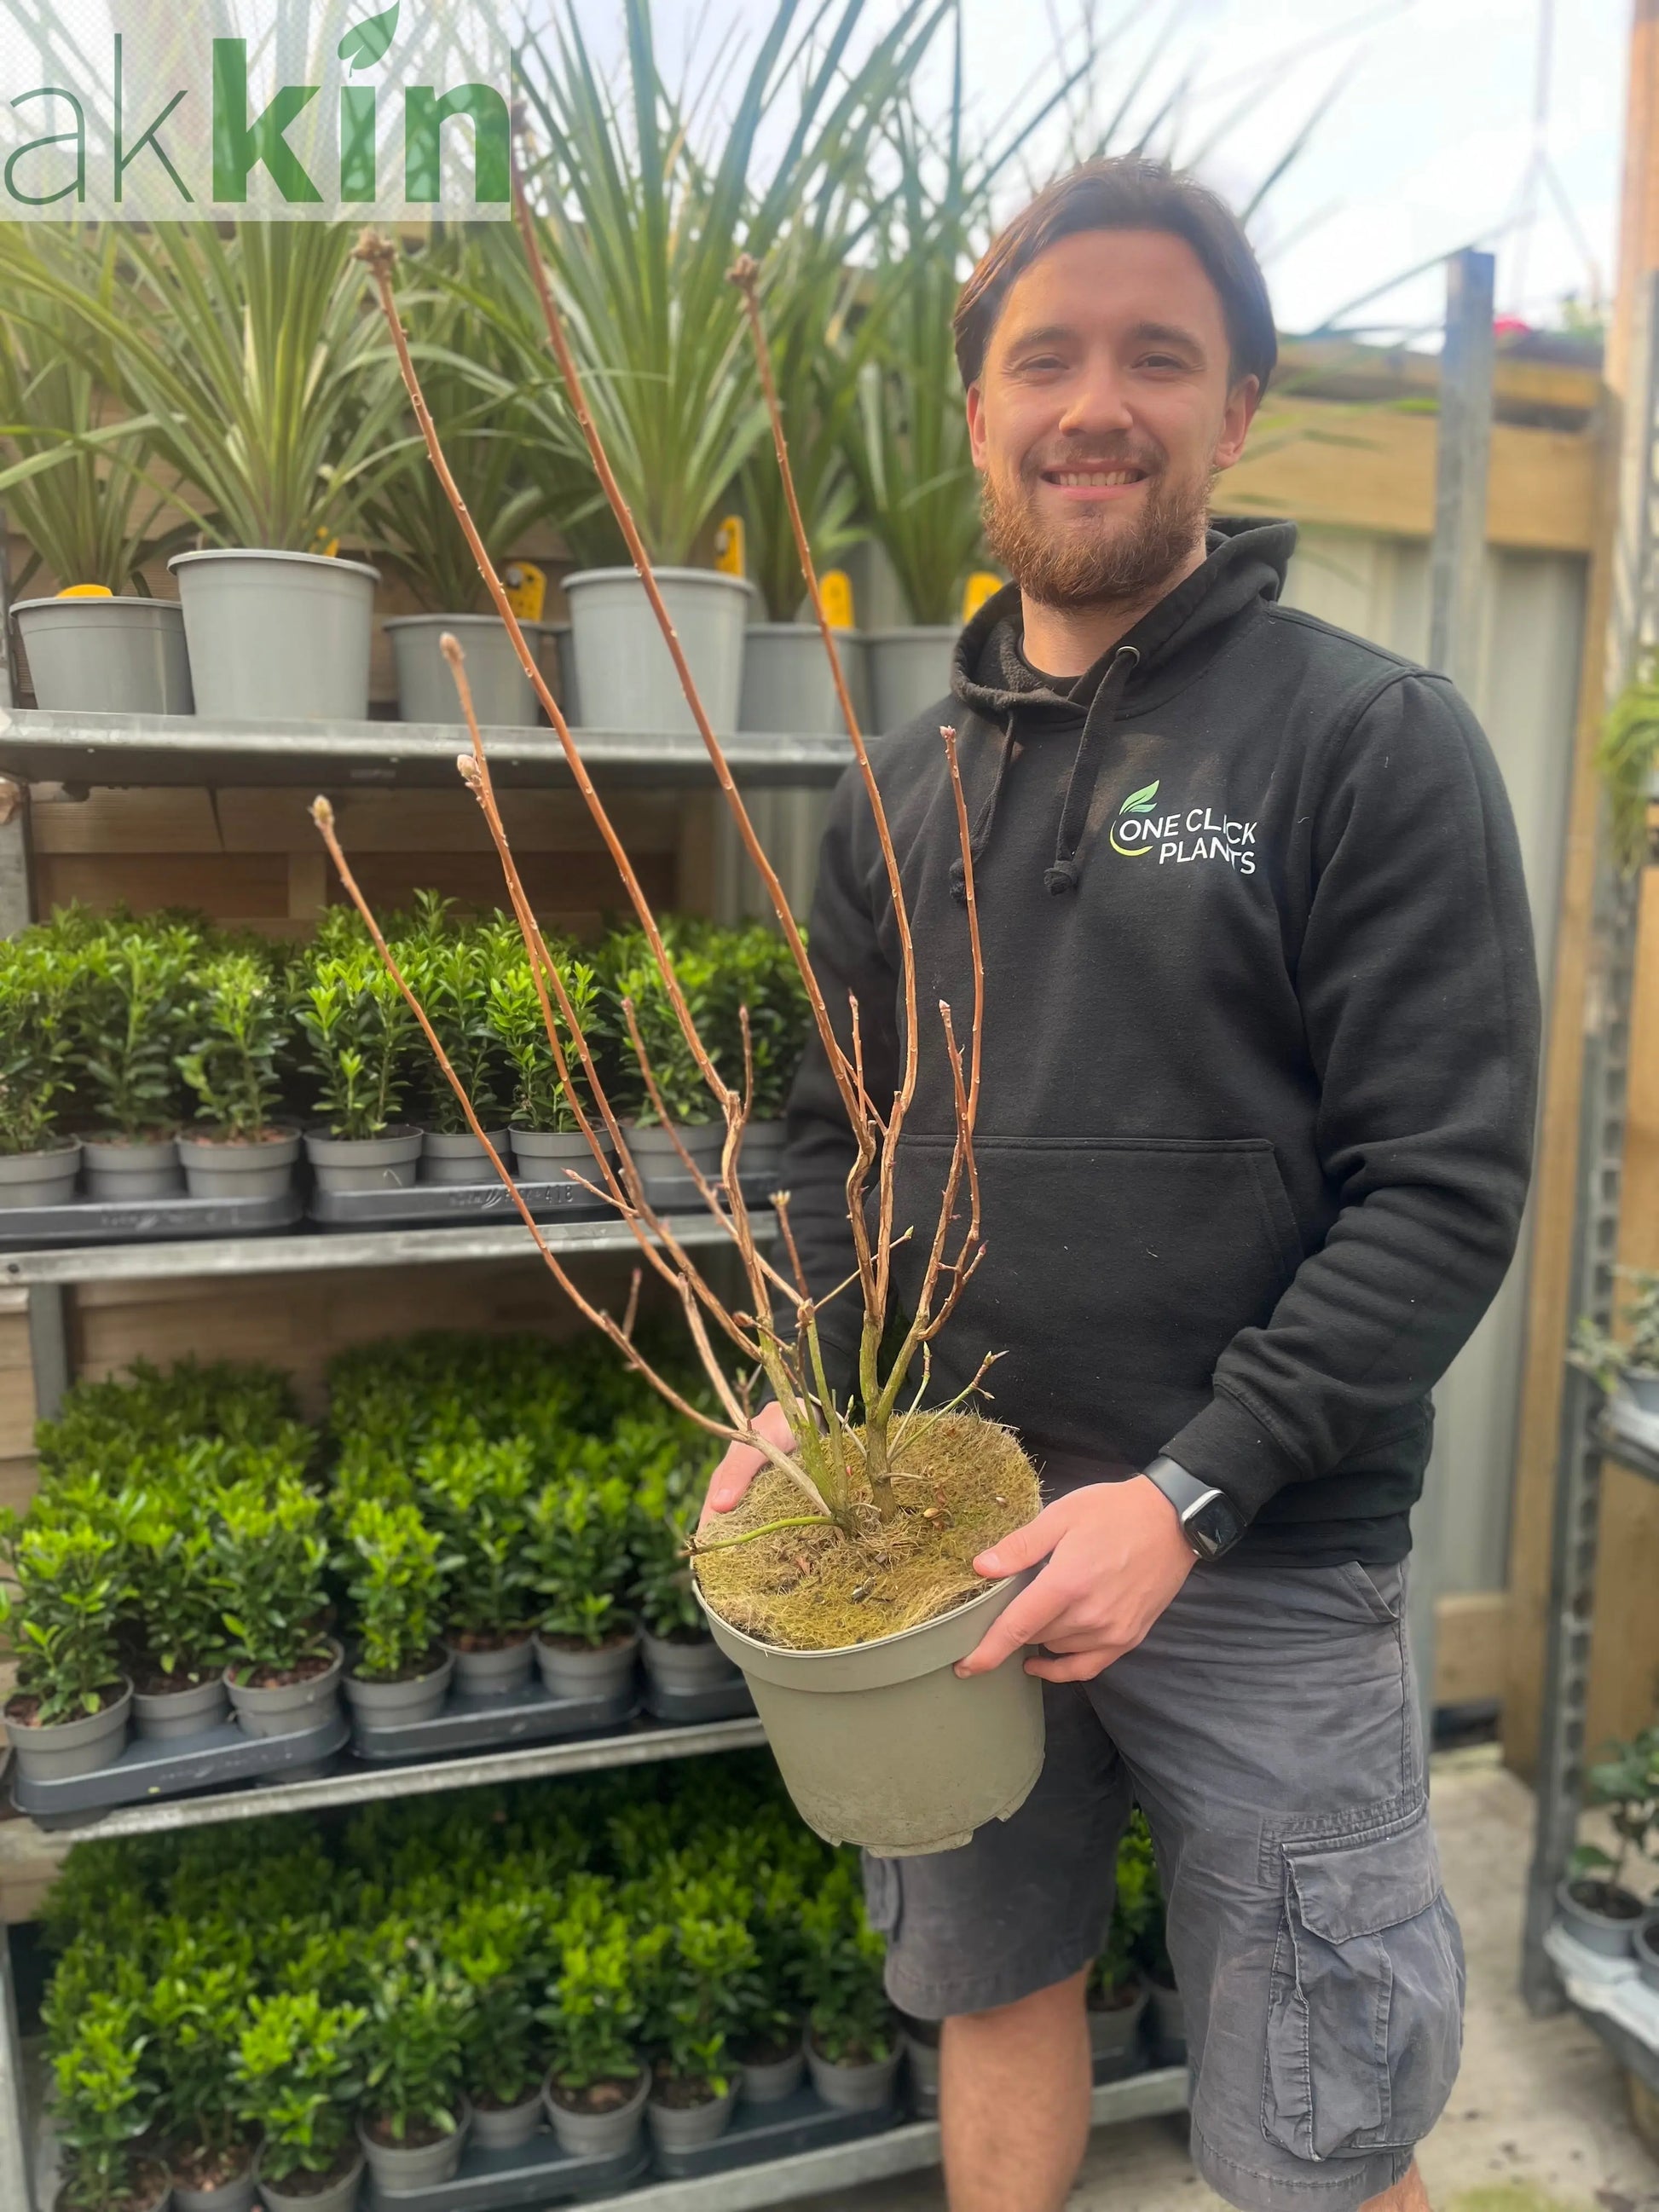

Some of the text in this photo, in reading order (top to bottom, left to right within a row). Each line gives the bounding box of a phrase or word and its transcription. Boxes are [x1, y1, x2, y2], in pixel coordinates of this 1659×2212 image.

[1119, 808, 1257, 846] ONE CLICK
[1159, 836, 1256, 875] PLANTS
